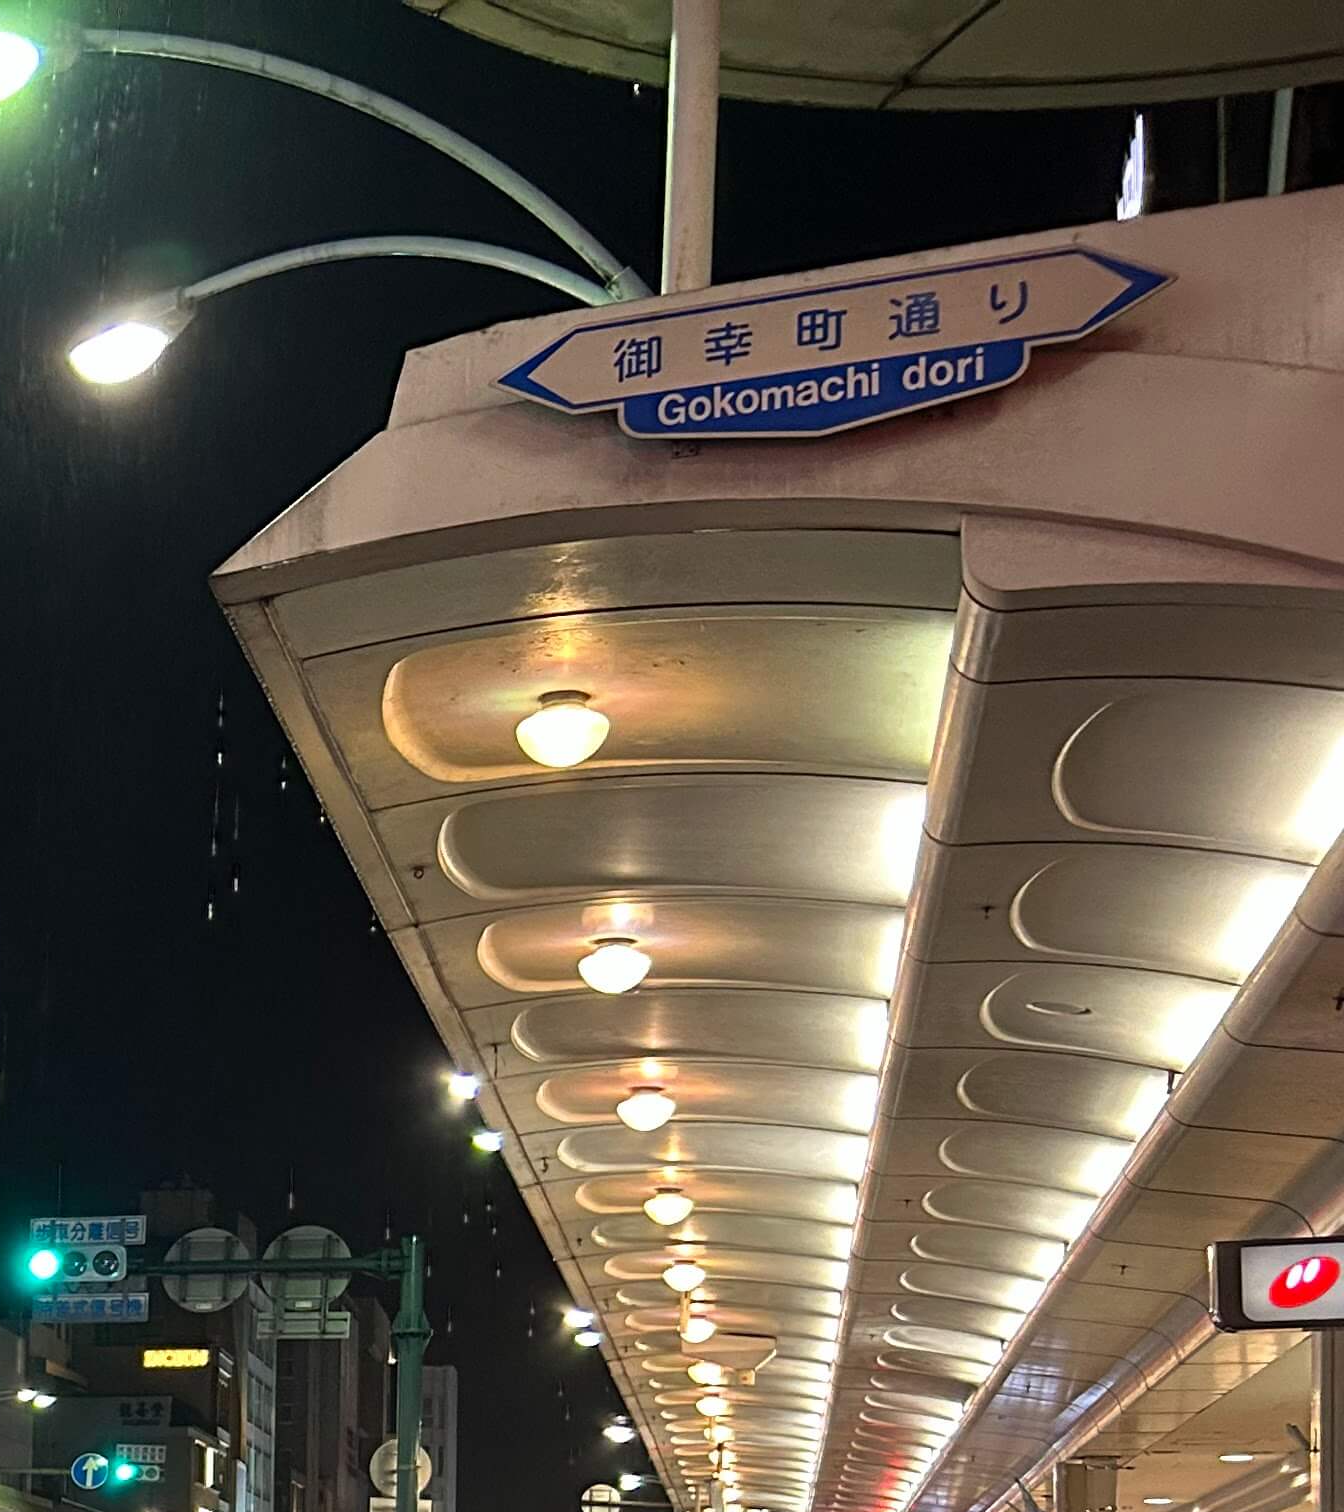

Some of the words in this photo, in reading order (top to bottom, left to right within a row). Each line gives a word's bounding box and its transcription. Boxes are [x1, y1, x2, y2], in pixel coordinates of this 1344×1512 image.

[613, 280, 1031, 384] 御幸町通り
[657, 362, 881, 428] Gokomachi
[901, 347, 985, 391] dori
